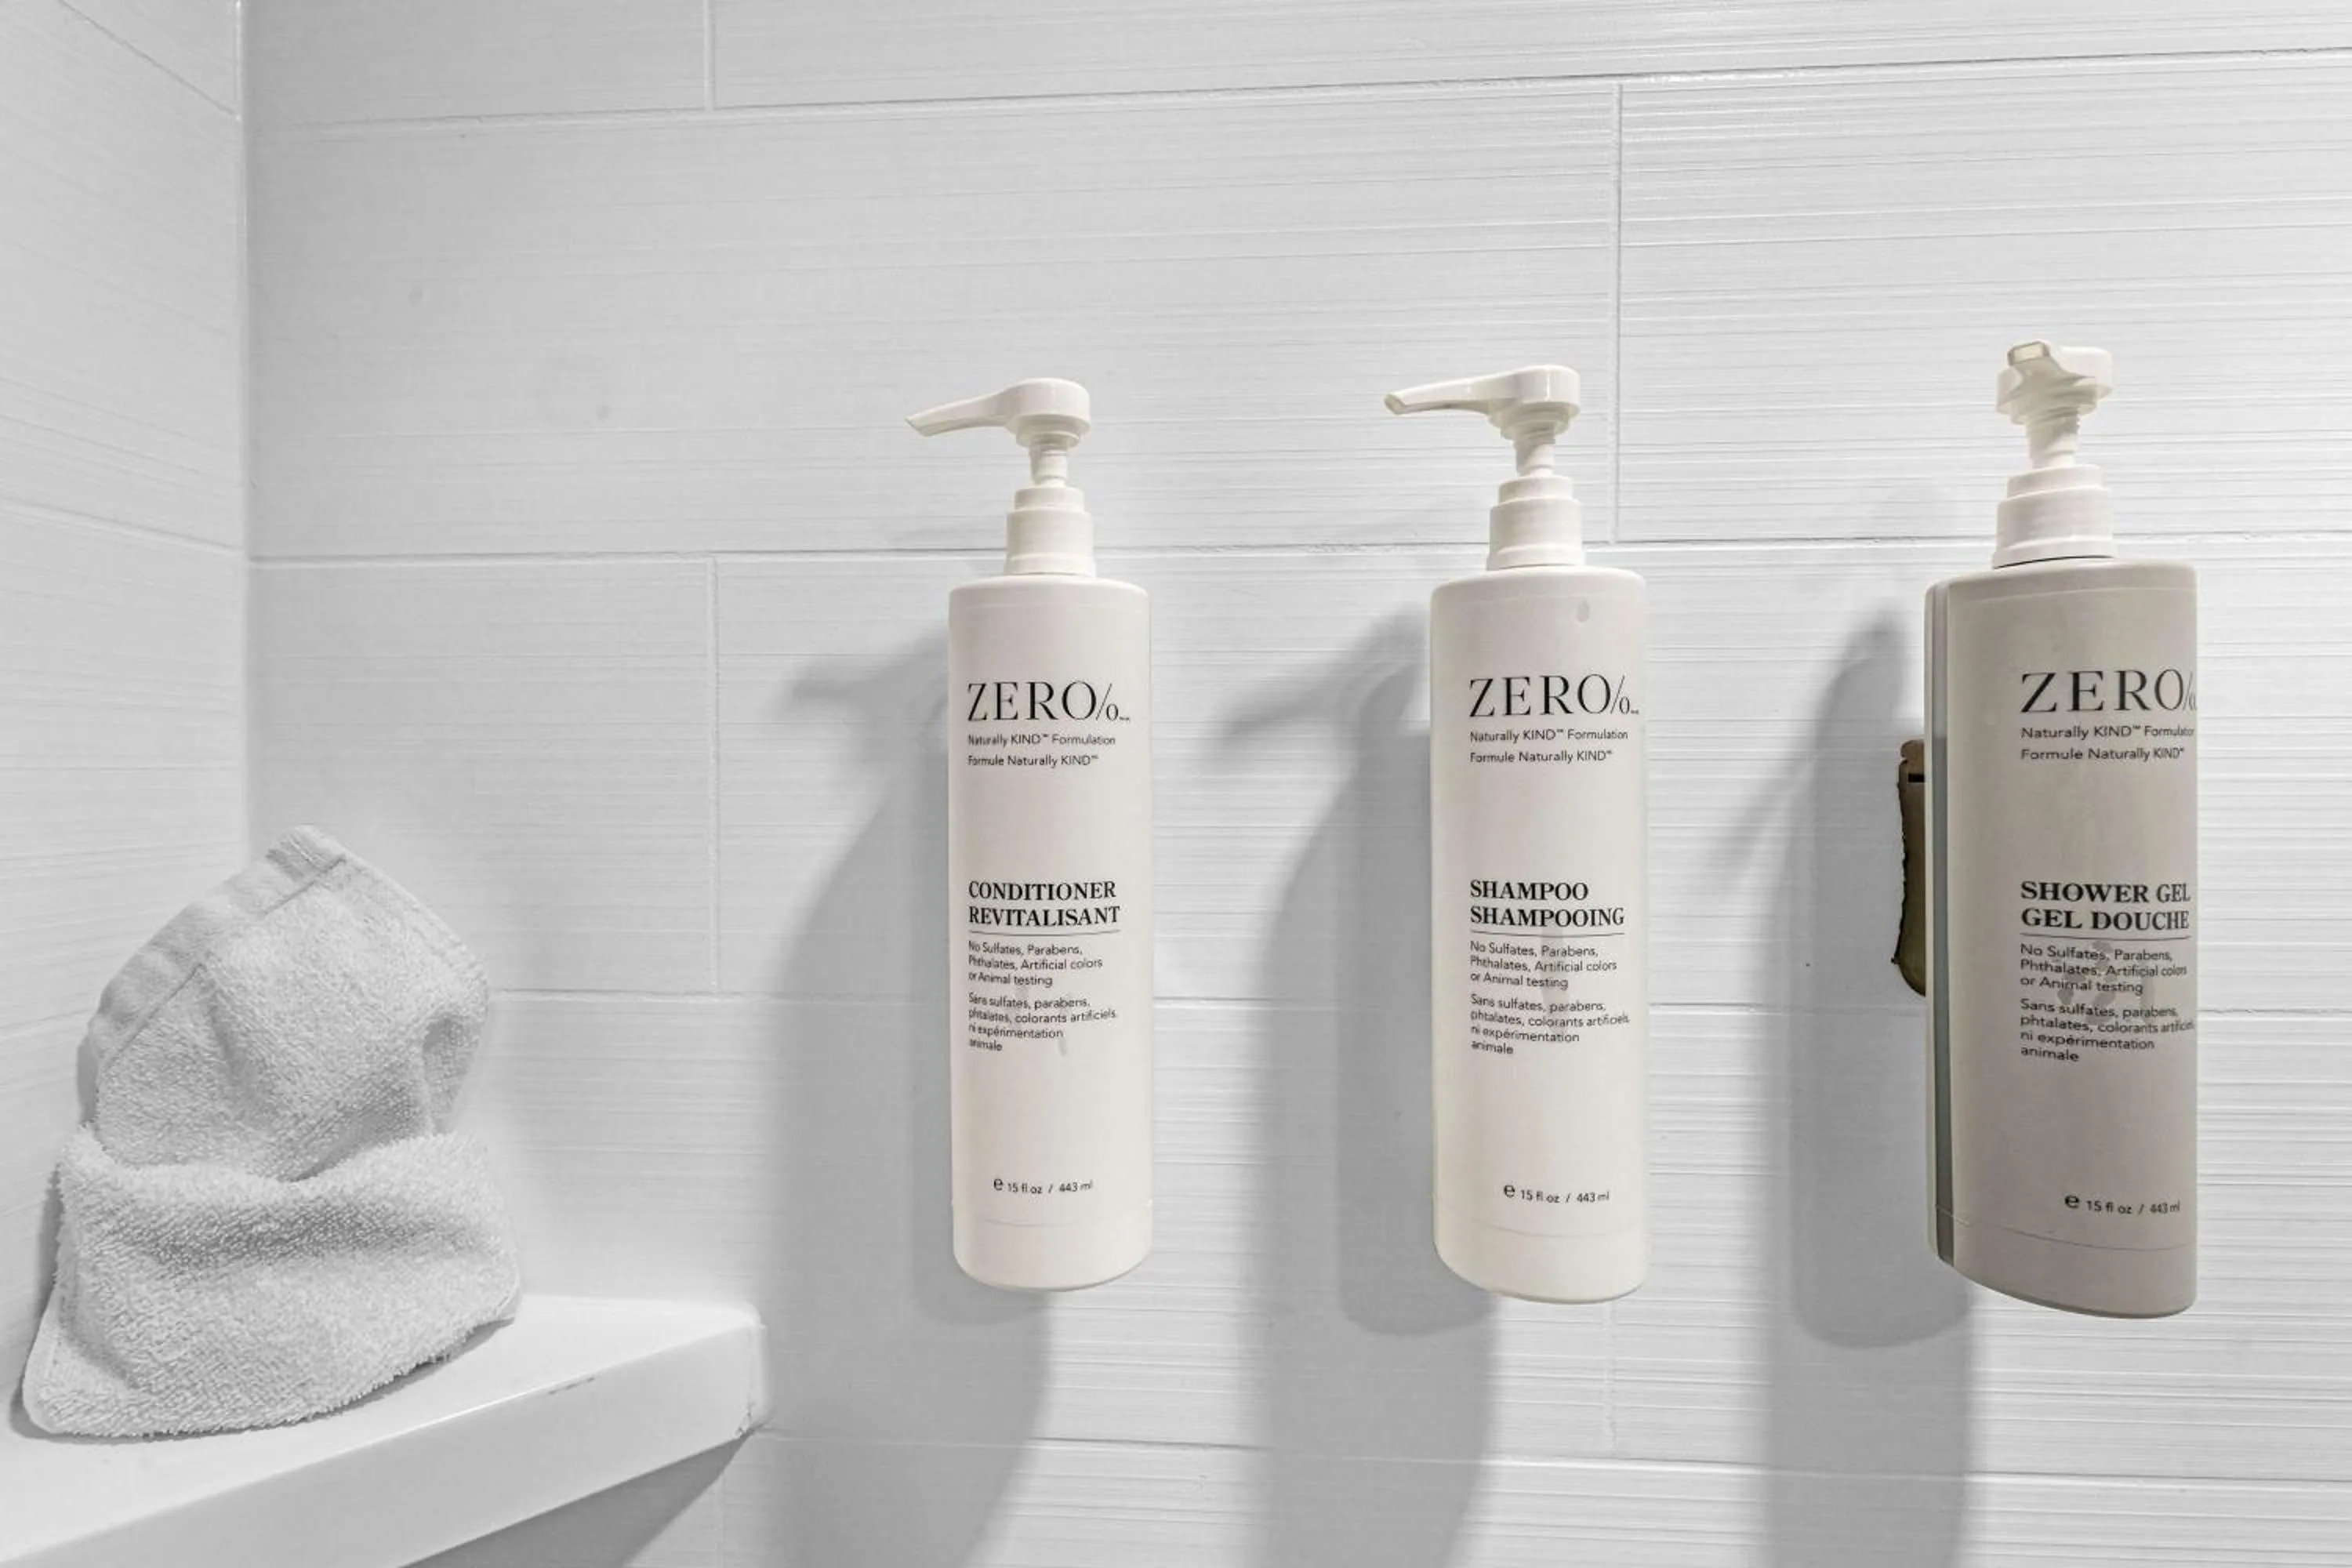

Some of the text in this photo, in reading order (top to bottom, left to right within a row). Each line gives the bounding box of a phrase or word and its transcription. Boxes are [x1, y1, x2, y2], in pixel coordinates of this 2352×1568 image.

[1470, 731, 1519, 743] Naturally
[1567, 729, 1628, 739] Formulation
[2021, 726, 2089, 739] Naturally
[968, 734, 1007, 747] Naturally
[1052, 735, 1116, 745] Formulation
[1470, 753, 1515, 763] Formule
[1519, 752, 1573, 764] Naturally
[2021, 748, 2082, 760] Formule
[2088, 747, 2150, 760] Naturally
[968, 755, 1004, 765] Formule
[1007, 755, 1058, 768] Naturally
[968, 880, 1116, 901] CONDITIONER
[1470, 880, 1588, 901] SHAMPOO
[2020, 881, 2190, 903] SHOWER GEL
[968, 906, 1120, 926] REVITALISANT
[1470, 906, 1624, 927] SHAMPOOING
[2021, 909, 2189, 931] GEL DOUCHE
[968, 941, 1083, 955] No Sulfates, Parabens,
[1470, 941, 1599, 957] No Sulfates, Parabens,
[2020, 944, 2172, 961] No Sulfates, Parabens,
[968, 957, 1102, 970] Phthalates, Artificial colors
[1470, 956, 1617, 972] Phthalates, Artificial colors
[2020, 960, 2187, 976] Phthalates, Artificial colors
[978, 973, 1011, 984] Animal
[1014, 975, 1053, 986] testing
[1483, 973, 1523, 985] Animal
[1526, 977, 1569, 990] testing
[2020, 977, 2143, 996] or Animal testing
[968, 992, 988, 1004] Sans
[989, 996, 1031, 1009] sulfates,
[1471, 994, 1494, 1007] Sans
[1498, 1000, 1546, 1011] sulfates,
[2020, 1000, 2055, 1012] Sans
[2059, 1003, 2118, 1017] sulfates,
[1015, 1014, 1067, 1023] colorants
[1470, 1011, 1524, 1026] phtalates,
[1528, 1016, 1583, 1026] colorants
[2020, 1015, 2093, 1033] phtalates,
[2098, 1022, 2158, 1033] colorants
[968, 1024, 1063, 1040] ni expérimentation
[1483, 1029, 1580, 1042] expérimentation
[969, 1040, 1002, 1051] animale
[1471, 1041, 1513, 1054] animale
[2021, 1031, 2154, 1050] ni expérimentation
[2021, 1047, 2079, 1062] animale
[1007, 1182, 1018, 1192] 15
[1022, 1183, 1027, 1192] fl
[1059, 1182, 1077, 1192] 443
[1080, 1179, 1092, 1190] ml
[1521, 1190, 1533, 1200] 15
[1536, 1192, 1543, 1201] fl
[1577, 1192, 1595, 1203] 443
[1597, 1191, 1610, 1200] ml
[2087, 1201, 2101, 1211] 15
[2106, 1202, 2114, 1212] fl
[2150, 1203, 2168, 1213] 443
[2170, 1200, 2180, 1212] ml
